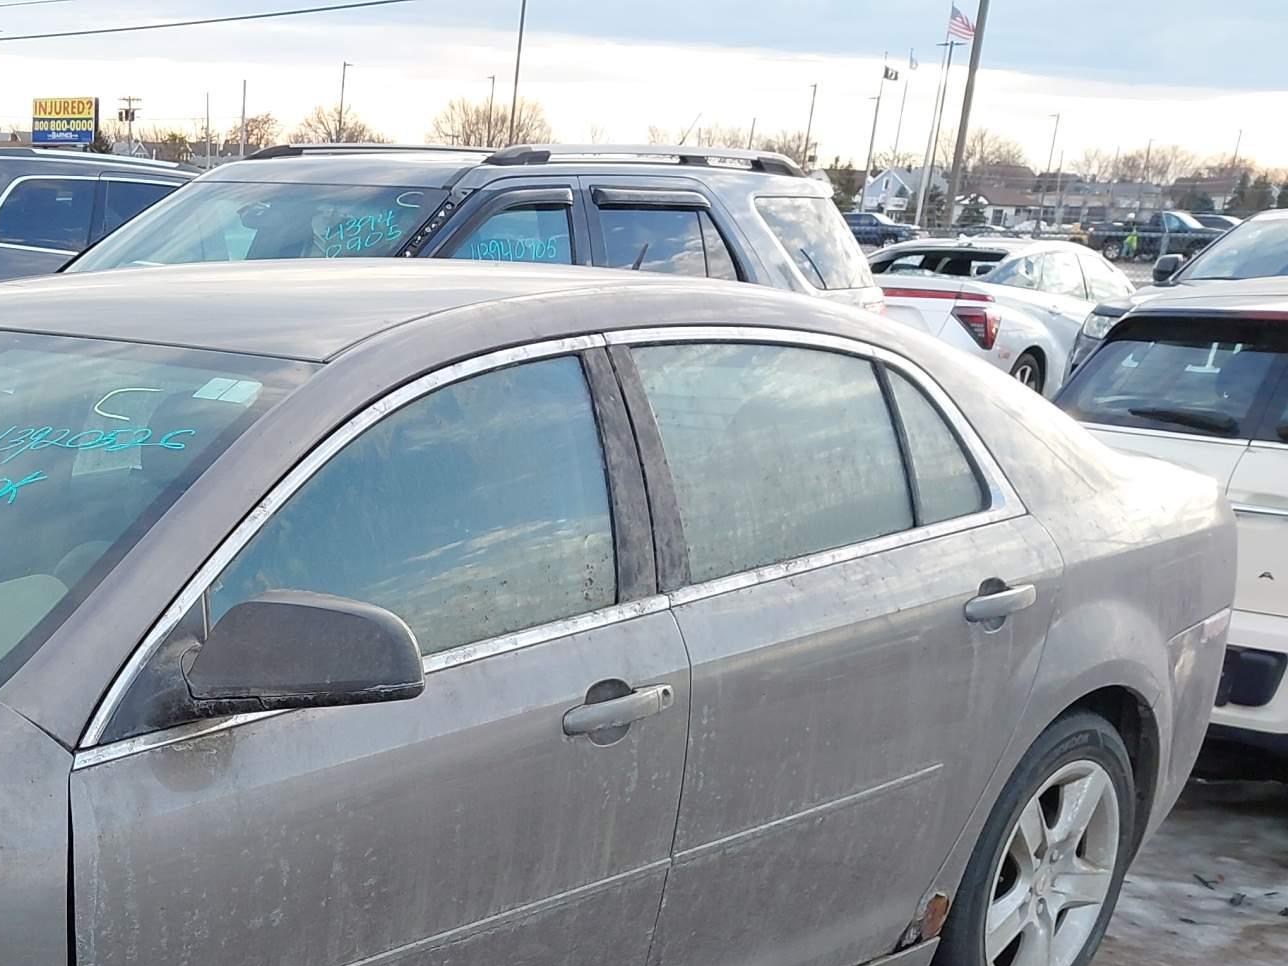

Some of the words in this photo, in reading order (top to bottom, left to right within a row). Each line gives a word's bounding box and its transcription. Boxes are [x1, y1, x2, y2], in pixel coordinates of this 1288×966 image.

[34, 100, 93, 116] INJURED?
[50, 119, 93, 131] 800-0000
[324, 210, 394, 241] 4394
[325, 224, 403, 258] 0905
